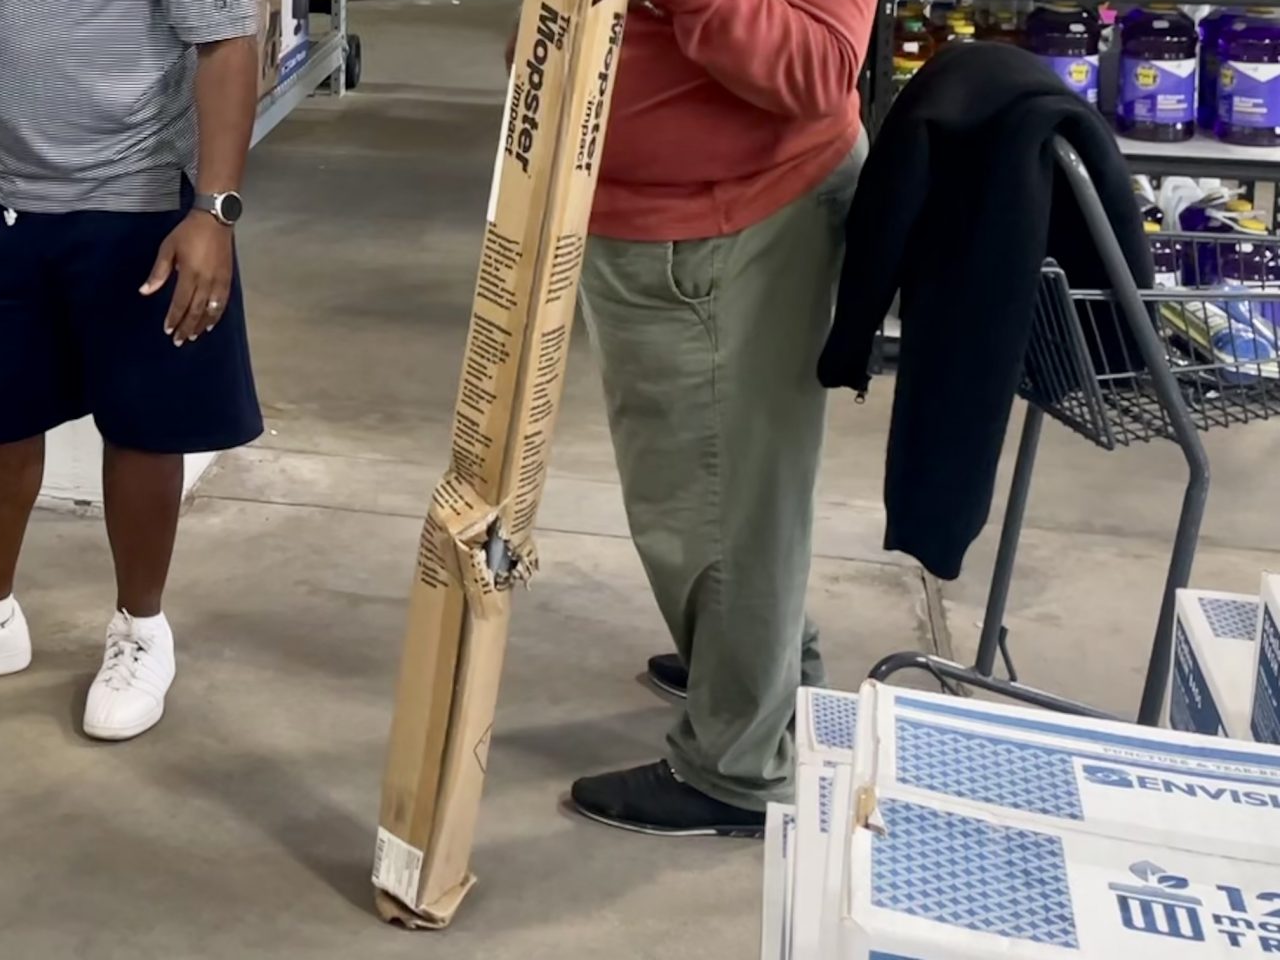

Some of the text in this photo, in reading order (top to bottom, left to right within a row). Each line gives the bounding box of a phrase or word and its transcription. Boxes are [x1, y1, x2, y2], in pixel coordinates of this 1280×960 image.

[554, 12, 571, 51] The
[513, 1, 560, 180] Mopster
[581, 11, 627, 178] Mopster
[1102, 746, 1189, 765] PUNCTURE
